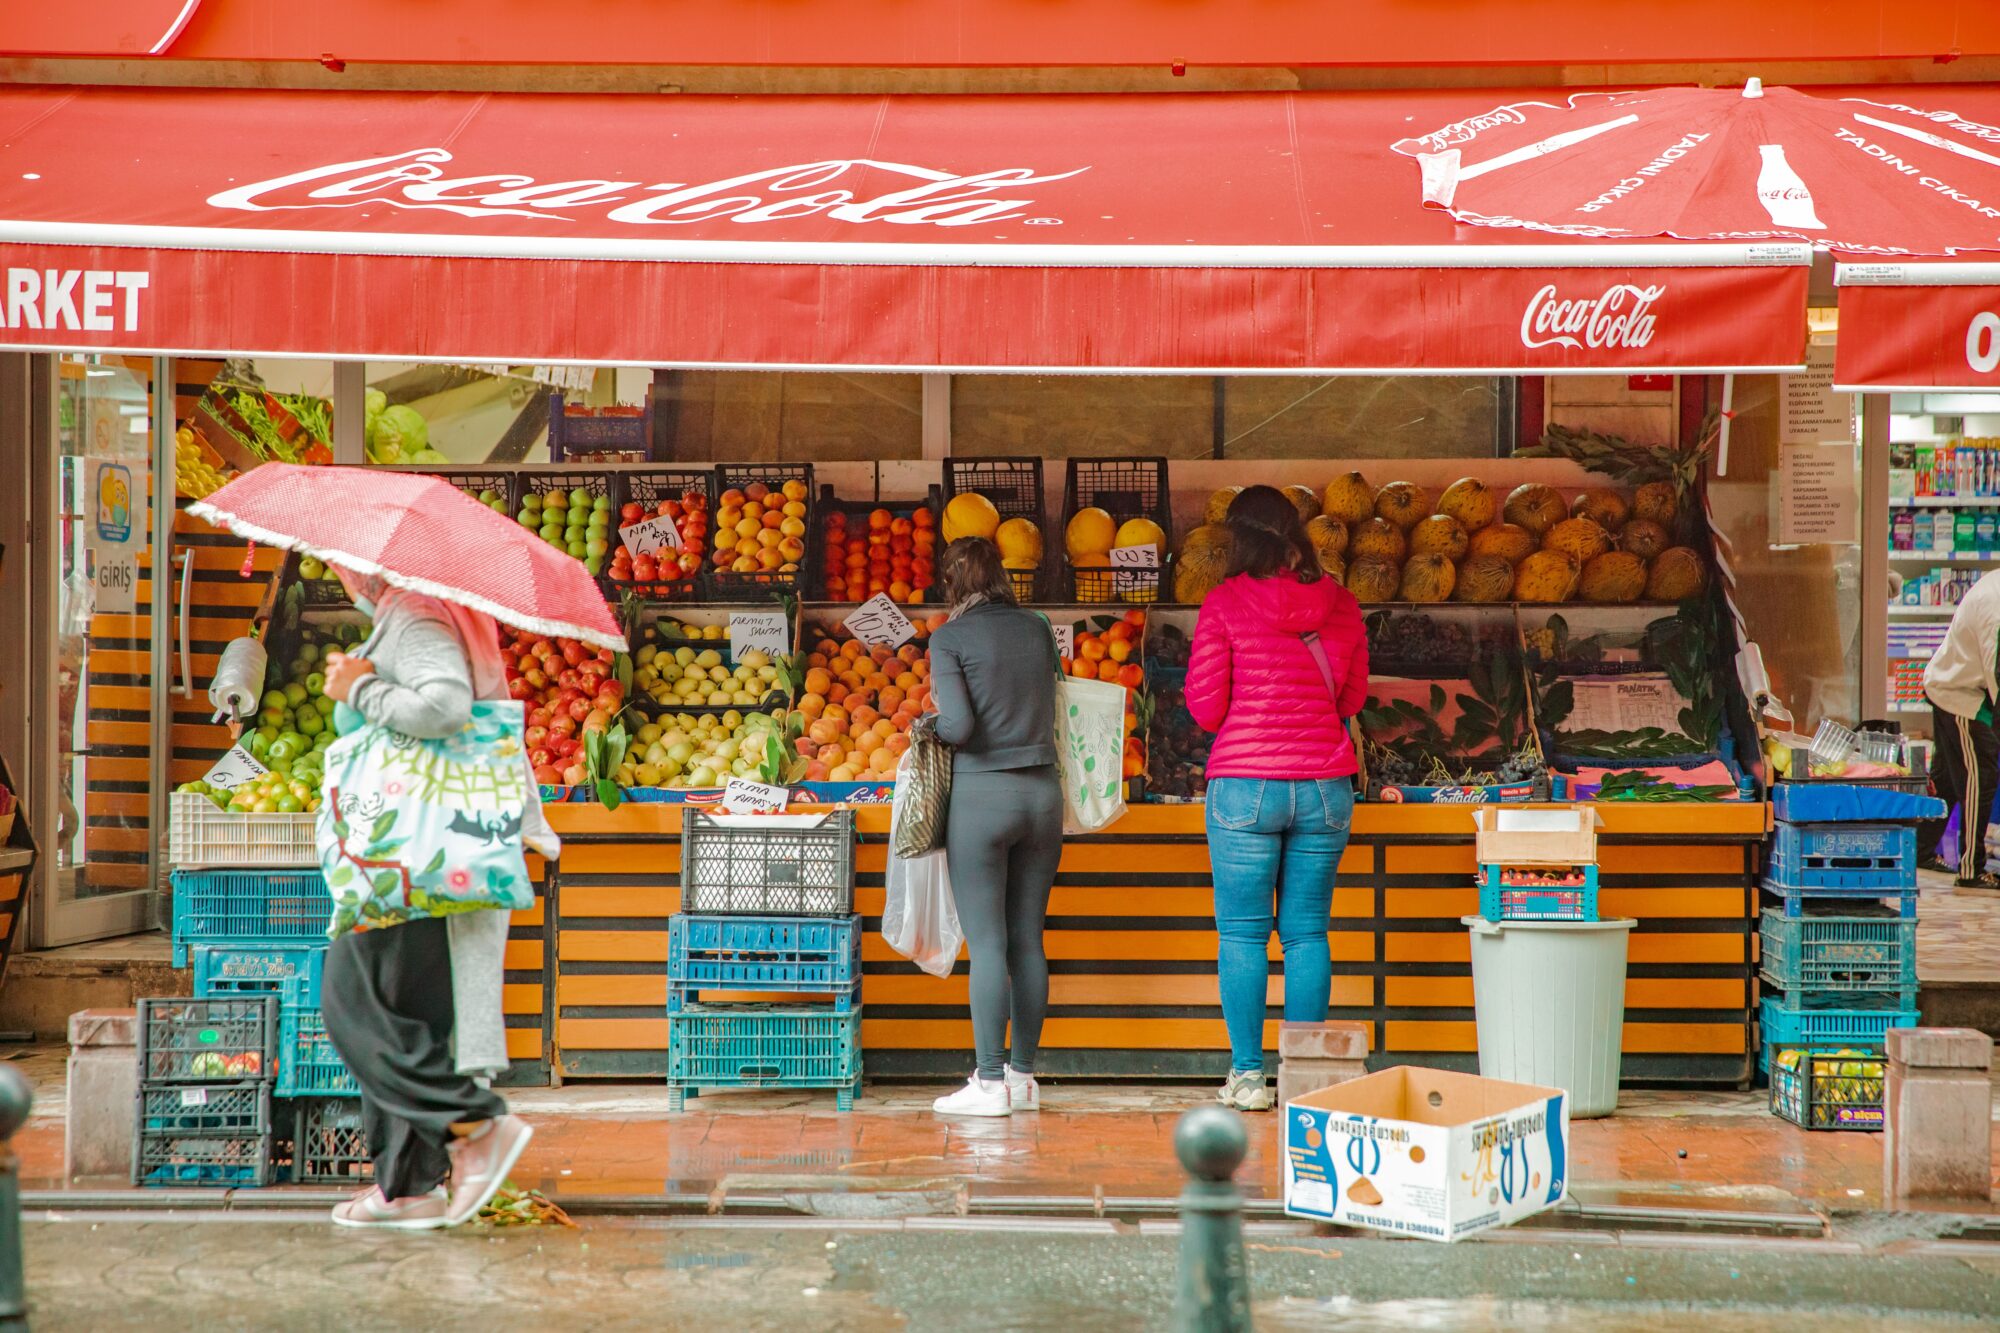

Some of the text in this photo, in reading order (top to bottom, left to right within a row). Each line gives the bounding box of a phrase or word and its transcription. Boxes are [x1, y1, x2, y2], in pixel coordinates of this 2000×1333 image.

[1575, 133, 1711, 213] TADINI ÇIKAR
[1834, 127, 1920, 175] TADINI
[206, 147, 1092, 227] Coca-Cola
[1521, 285, 1666, 350] Coca-Cola
[629, 522, 654, 538] NAR
[99, 560, 131, 593] GİRİŞ
[729, 780, 770, 795] ELMA
